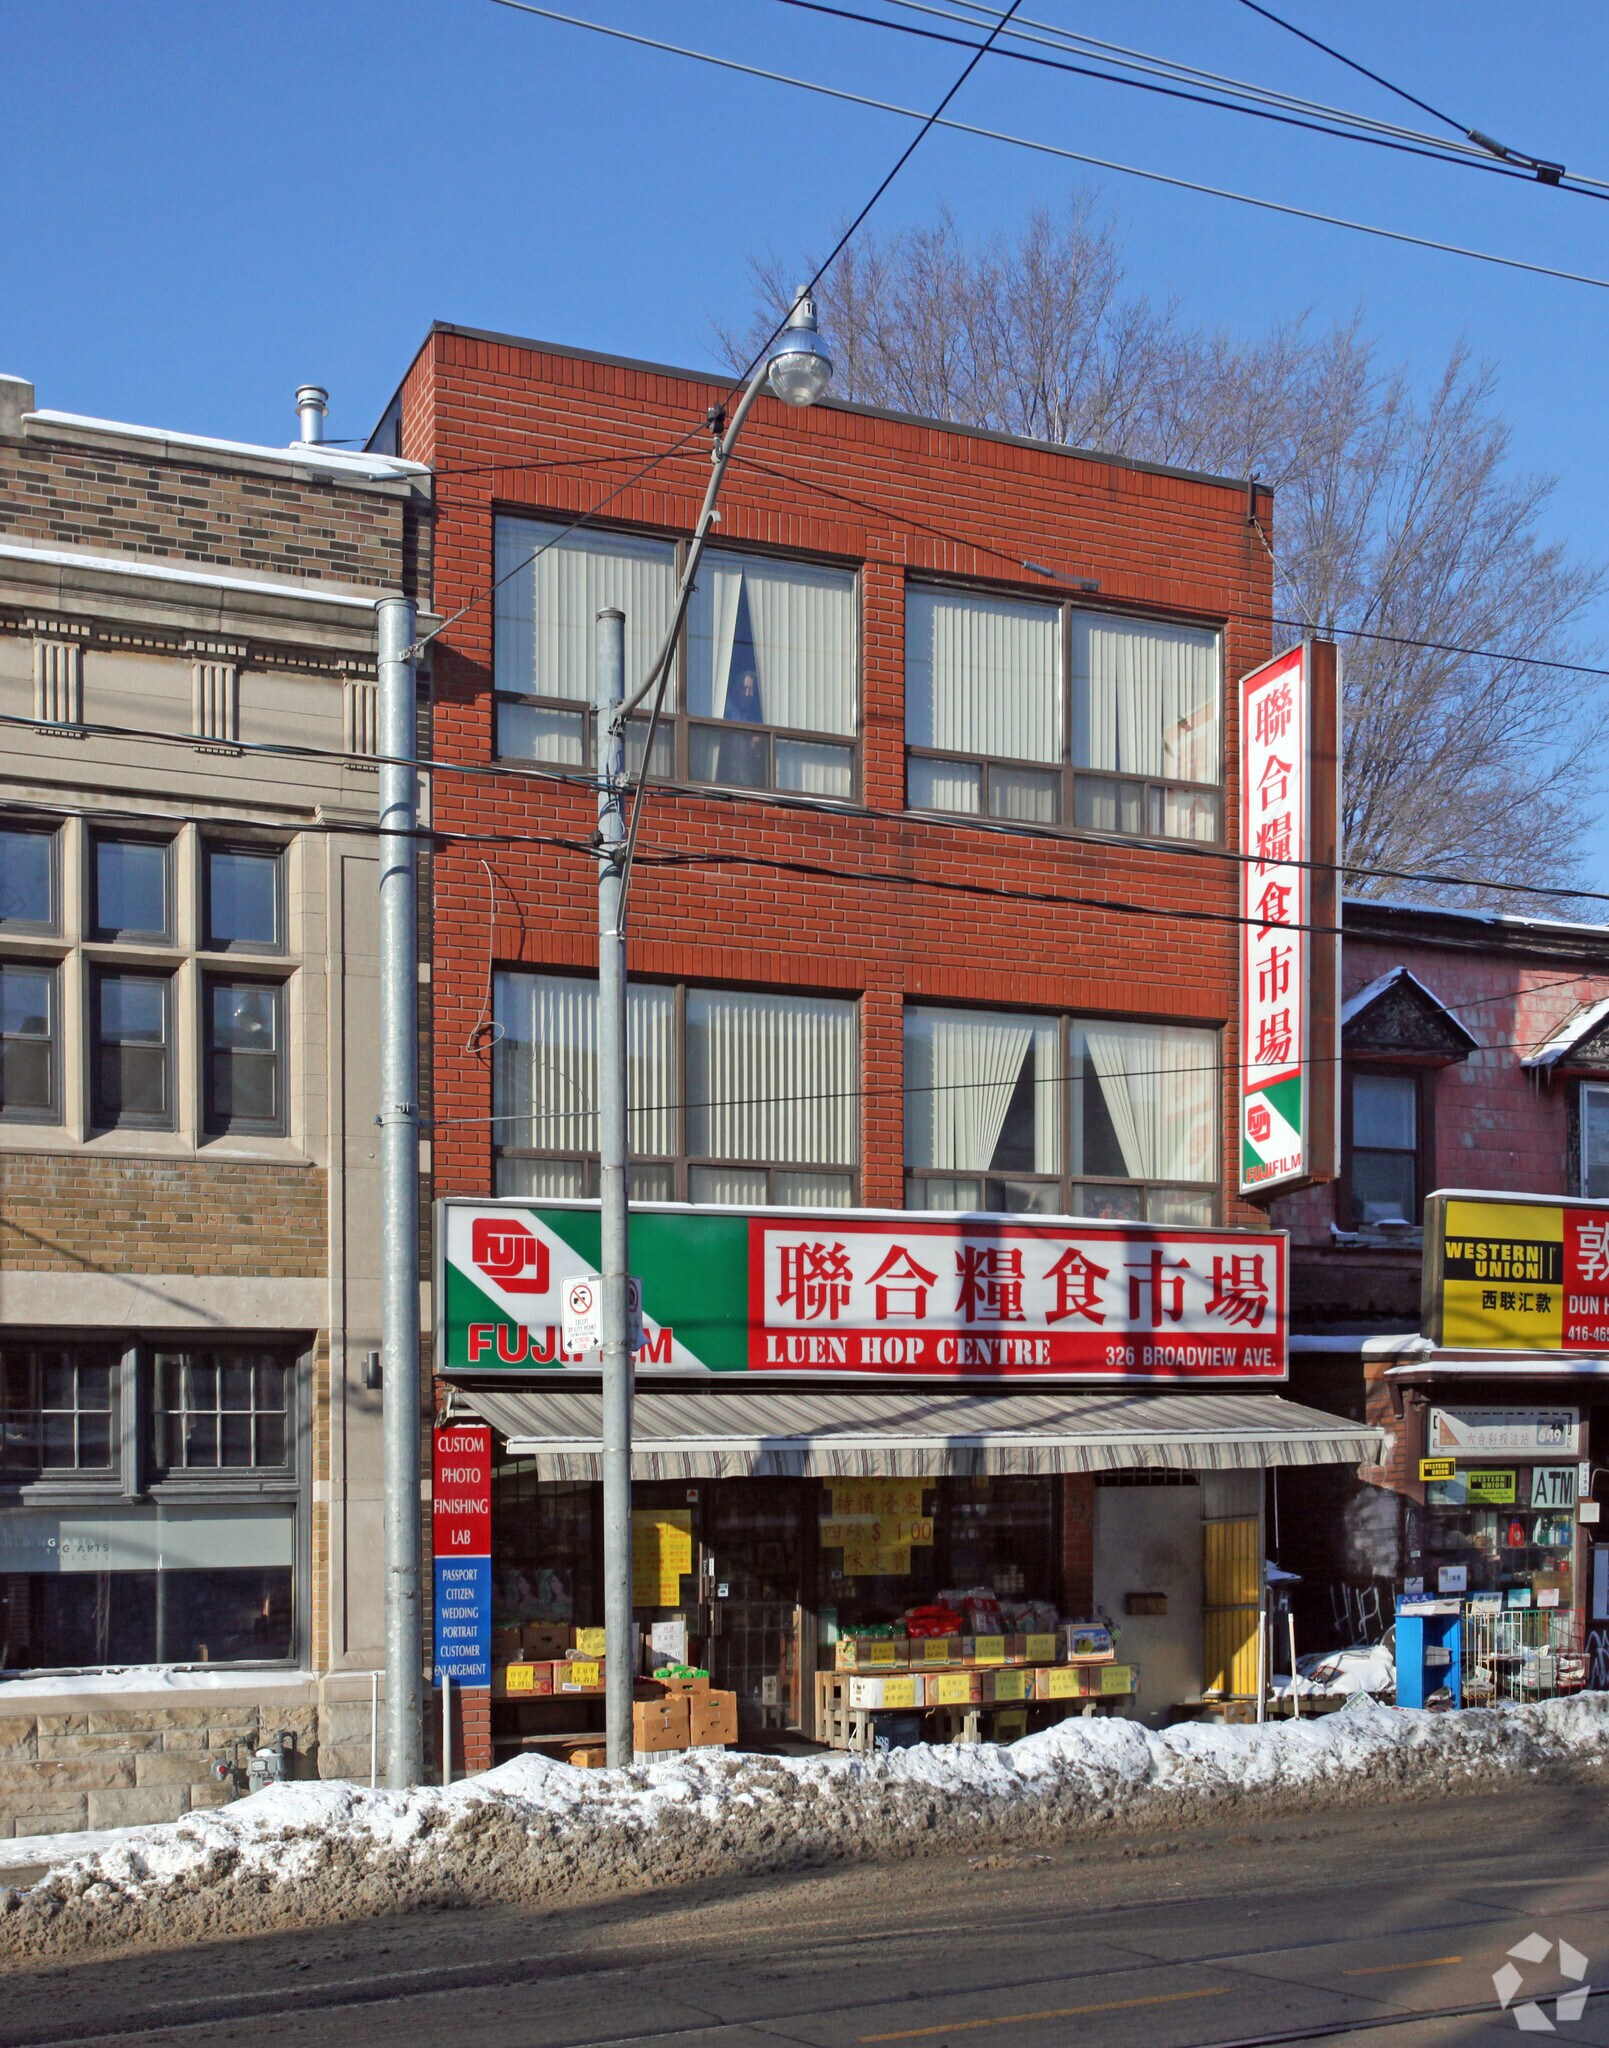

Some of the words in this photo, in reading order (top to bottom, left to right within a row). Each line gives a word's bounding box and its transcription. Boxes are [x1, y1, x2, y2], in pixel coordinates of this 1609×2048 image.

[1255, 681, 1293, 1069] 聯合糧食市場
[1246, 1153, 1301, 1184] FUJIFILM
[1445, 1242, 1538, 1262] WESTERN
[1475, 1261, 1538, 1279] UNION
[776, 1241, 1269, 1329] 聯合糧食市場
[1482, 1290, 1551, 1313] 西联汇款
[1569, 1295, 1599, 1315] DUN
[766, 1335, 848, 1364] LUEN
[860, 1336, 924, 1364] HOP
[937, 1336, 1051, 1366] CENTRE
[1105, 1346, 1135, 1367] 326
[1143, 1346, 1237, 1367] BROADVIEW
[1243, 1348, 1276, 1368] AVE.
[438, 1437, 484, 1452] CUSTOM
[441, 1467, 481, 1484] PHOTO
[1534, 1471, 1573, 1504] ATM
[434, 1499, 489, 1515] FINISHING
[451, 1530, 471, 1545] LAB
[442, 1569, 478, 1581] PASSPORT
[446, 1588, 475, 1600] CITIZEN
[442, 1607, 479, 1619] WEDDING
[442, 1625, 478, 1637] PORTRAIT
[440, 1644, 480, 1657] CUSTOMER
[434, 1663, 486, 1676] ENLARGEMENT
